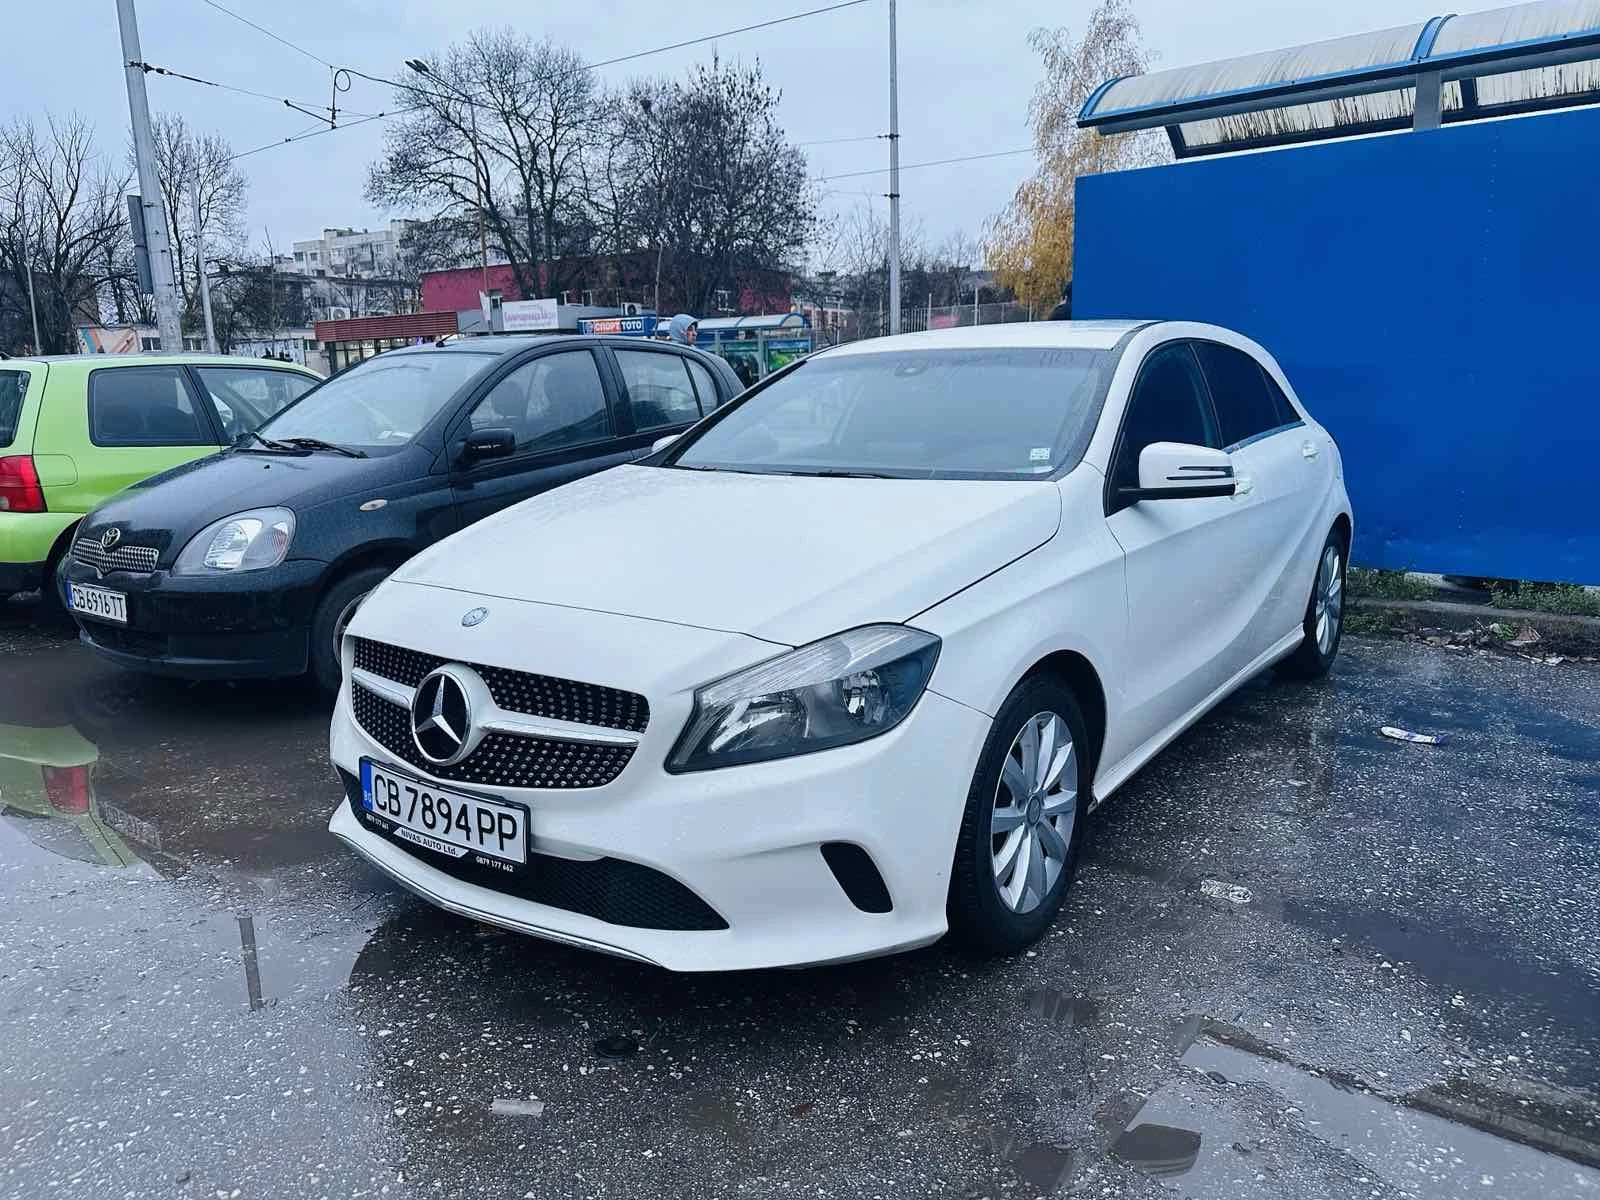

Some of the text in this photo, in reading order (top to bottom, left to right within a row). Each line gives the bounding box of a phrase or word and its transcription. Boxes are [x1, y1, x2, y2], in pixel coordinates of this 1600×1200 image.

[621, 320, 642, 331] ТОТО
[401, 829, 458, 856] NIVAS AUTO Ltd.
[491, 860, 501, 869] 177
